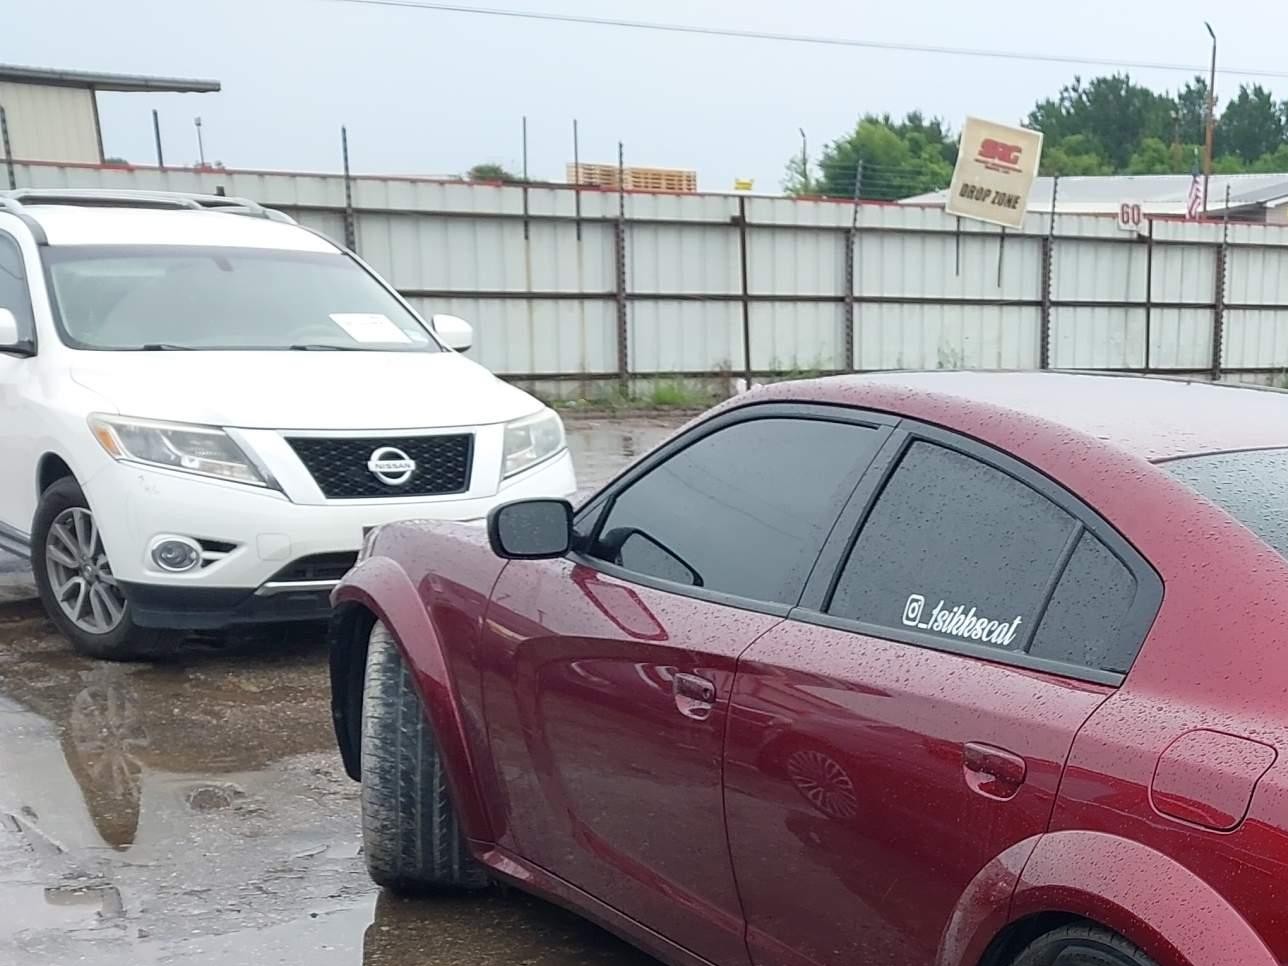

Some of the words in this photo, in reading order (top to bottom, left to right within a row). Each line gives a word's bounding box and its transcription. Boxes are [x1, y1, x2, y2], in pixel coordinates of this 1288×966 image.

[959, 183, 992, 202] DROP
[991, 190, 1021, 210] ZONE
[1121, 203, 1141, 226] 60
